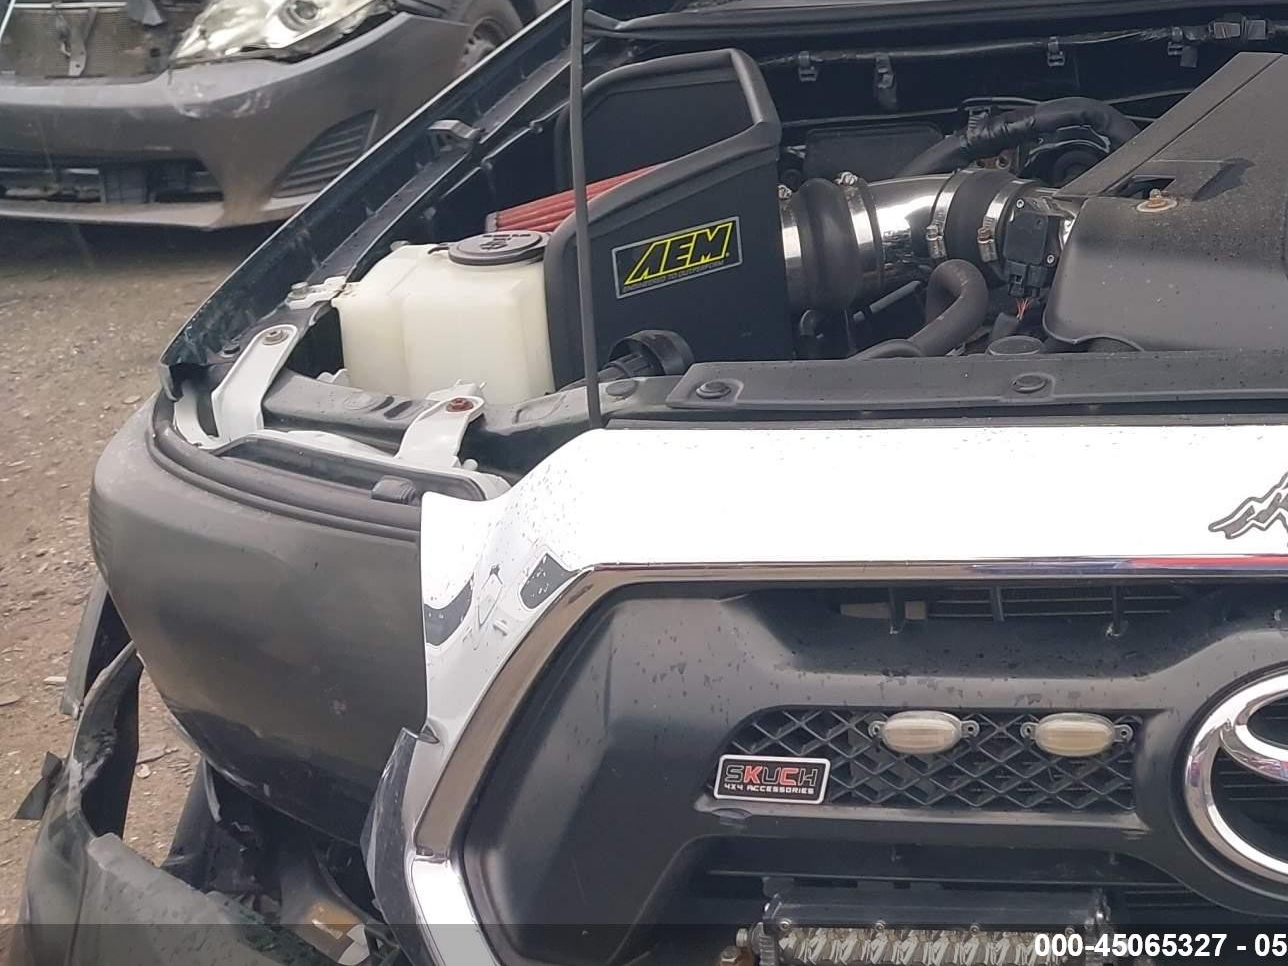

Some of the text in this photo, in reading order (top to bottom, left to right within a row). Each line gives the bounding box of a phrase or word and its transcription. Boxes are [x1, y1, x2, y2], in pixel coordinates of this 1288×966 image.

[624, 222, 733, 285] AEM
[724, 764, 819, 786] SKUCH
[746, 785, 815, 795] ACCESSORIES
